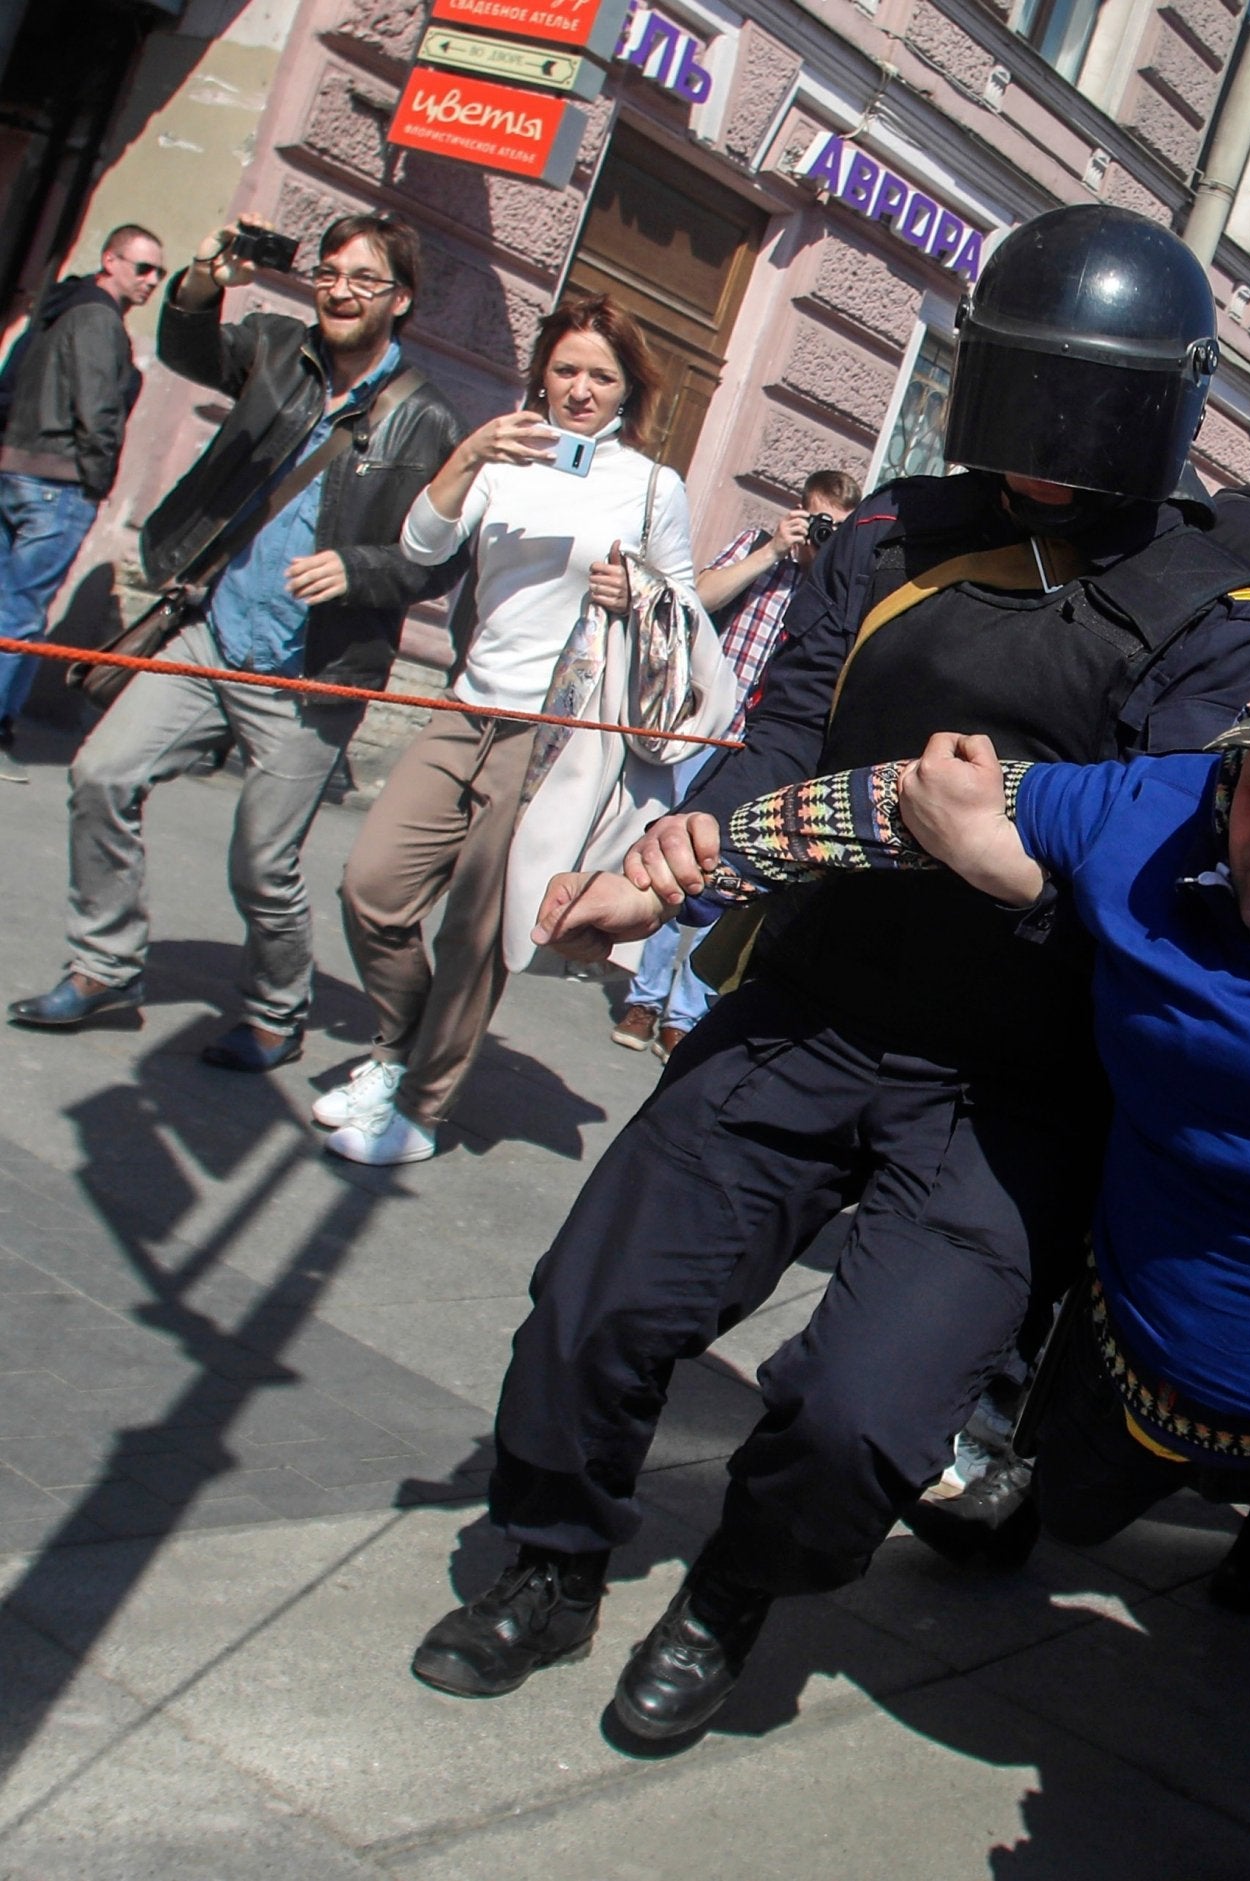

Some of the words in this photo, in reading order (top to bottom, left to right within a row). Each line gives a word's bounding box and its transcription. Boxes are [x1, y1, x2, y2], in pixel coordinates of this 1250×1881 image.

[530, 12, 581, 31] АТЕЛЬЕ
[497, 145, 537, 164] АТЕЛЬЕ
[803, 133, 984, 283] АВРОРА
